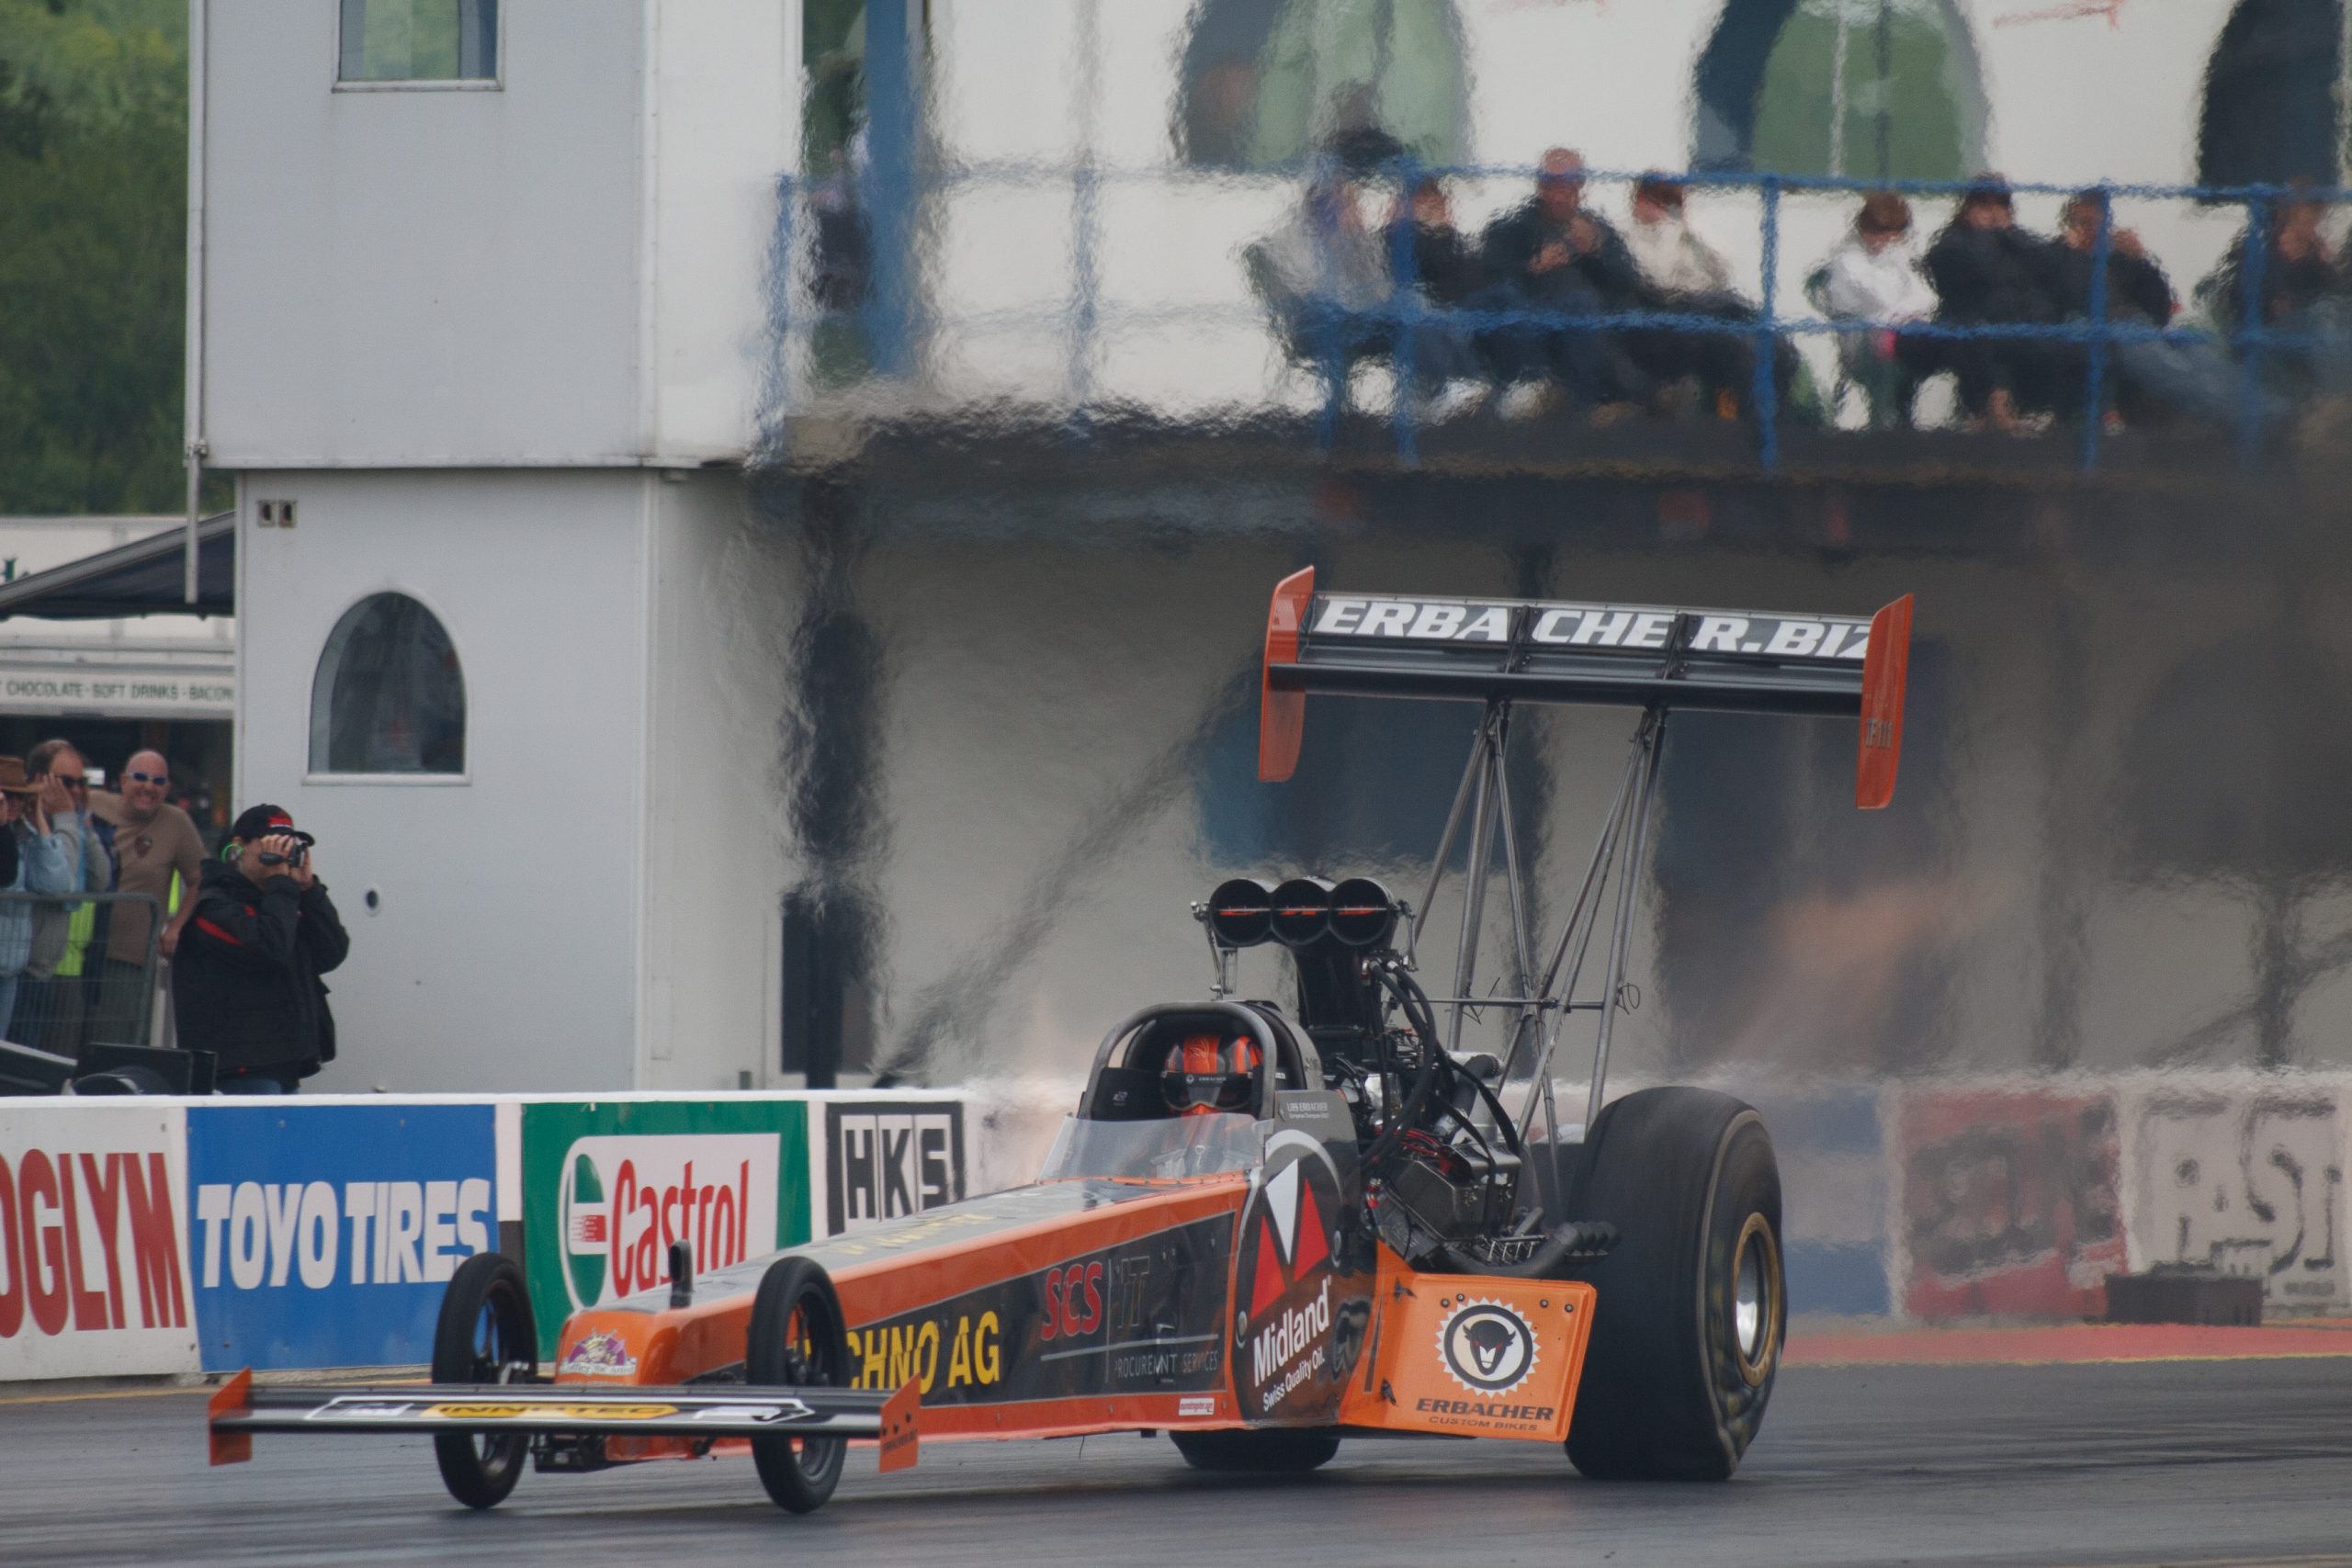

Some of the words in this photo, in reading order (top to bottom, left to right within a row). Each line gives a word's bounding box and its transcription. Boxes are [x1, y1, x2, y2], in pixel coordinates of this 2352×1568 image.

[6, 681, 83, 698] CHOCOLATE
[93, 683, 125, 699] SOFT
[130, 684, 178, 701] DRINKS
[843, 1127, 946, 1221] HKS
[197, 1181, 337, 1290] TOYO
[345, 1179, 491, 1284] TIRES
[611, 1159, 750, 1299] Castrol
[1041, 1260, 1102, 1341] SCS
[1253, 1278, 1329, 1387] Midland
[948, 1310, 1000, 1388] AG
[1262, 1382, 1285, 1412] Swiss
[1284, 1357, 1312, 1393] Quality
[1416, 1397, 1555, 1421] ERBACHER
[1429, 1416, 1490, 1428] CUSTOM
[1494, 1422, 1538, 1431] BIKES
